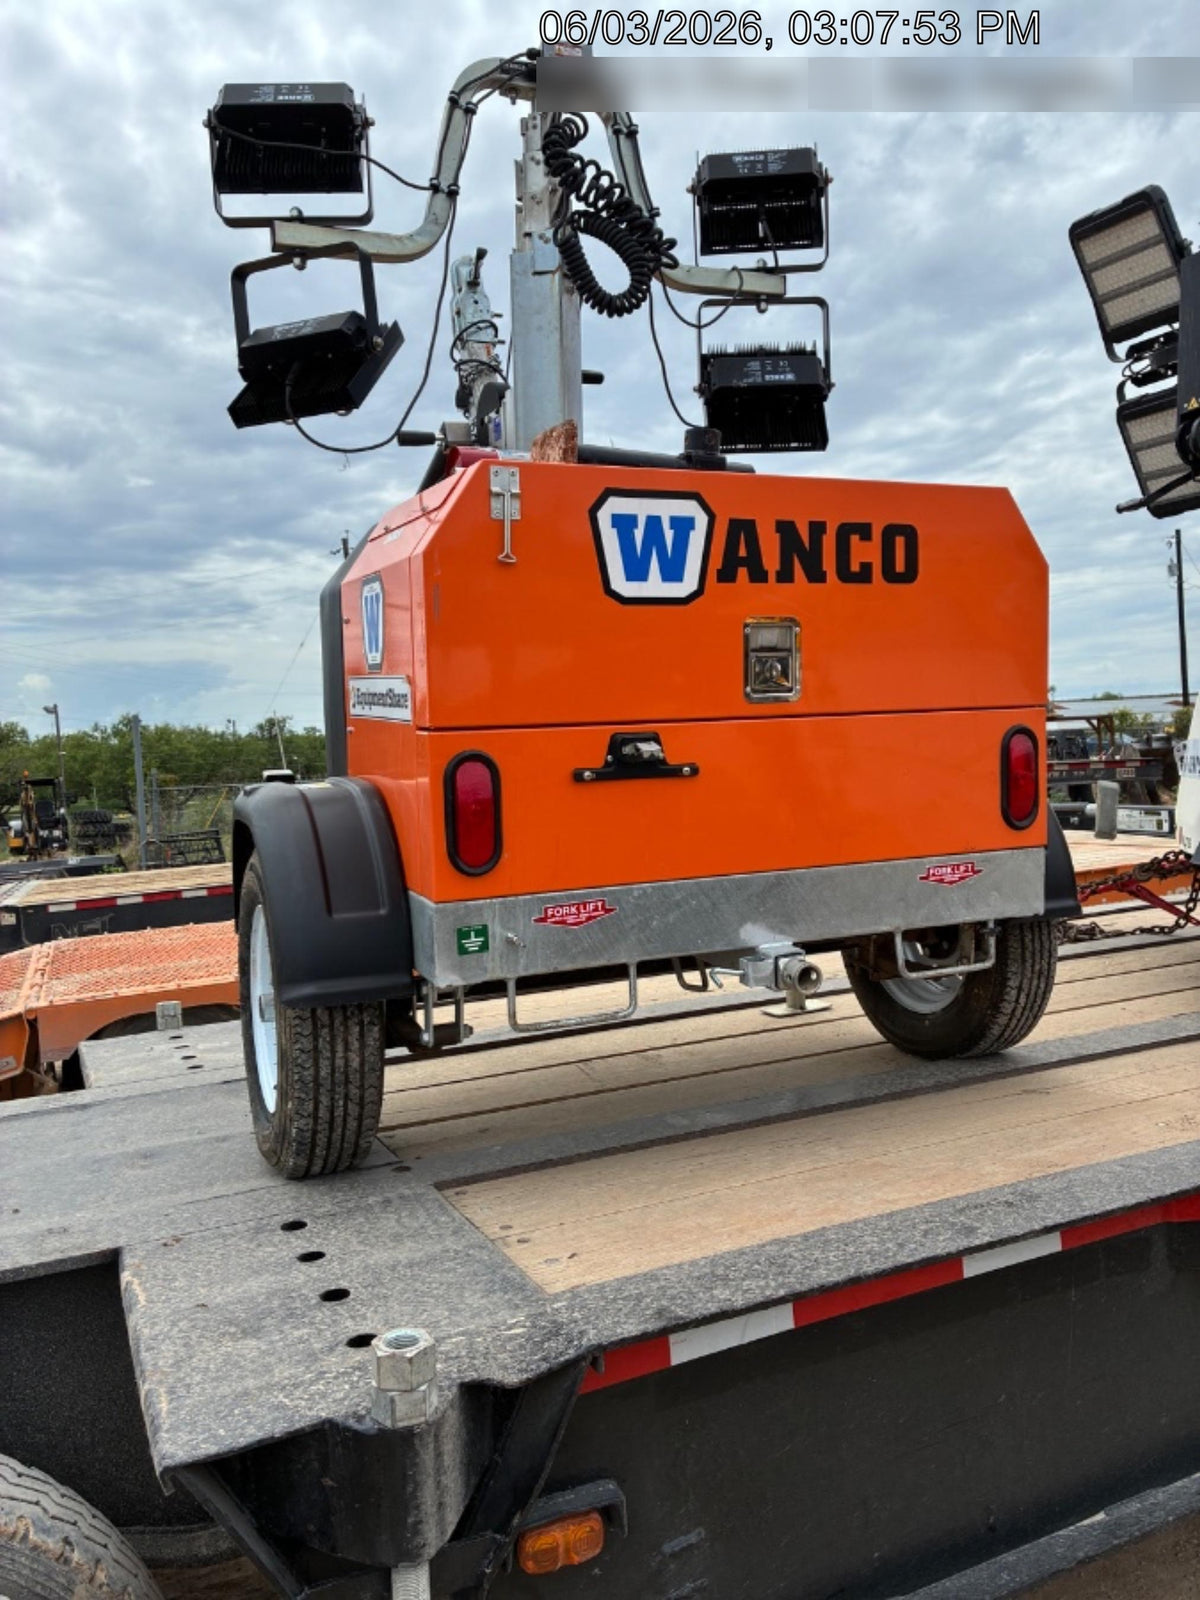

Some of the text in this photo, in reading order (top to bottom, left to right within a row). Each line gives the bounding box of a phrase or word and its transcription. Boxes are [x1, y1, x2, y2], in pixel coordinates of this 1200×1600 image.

[611, 513, 919, 585] WANCO
[356, 687, 408, 710] EquipmentShare
[546, 904, 579, 919] FORK
[579, 901, 604, 913] LIFT
